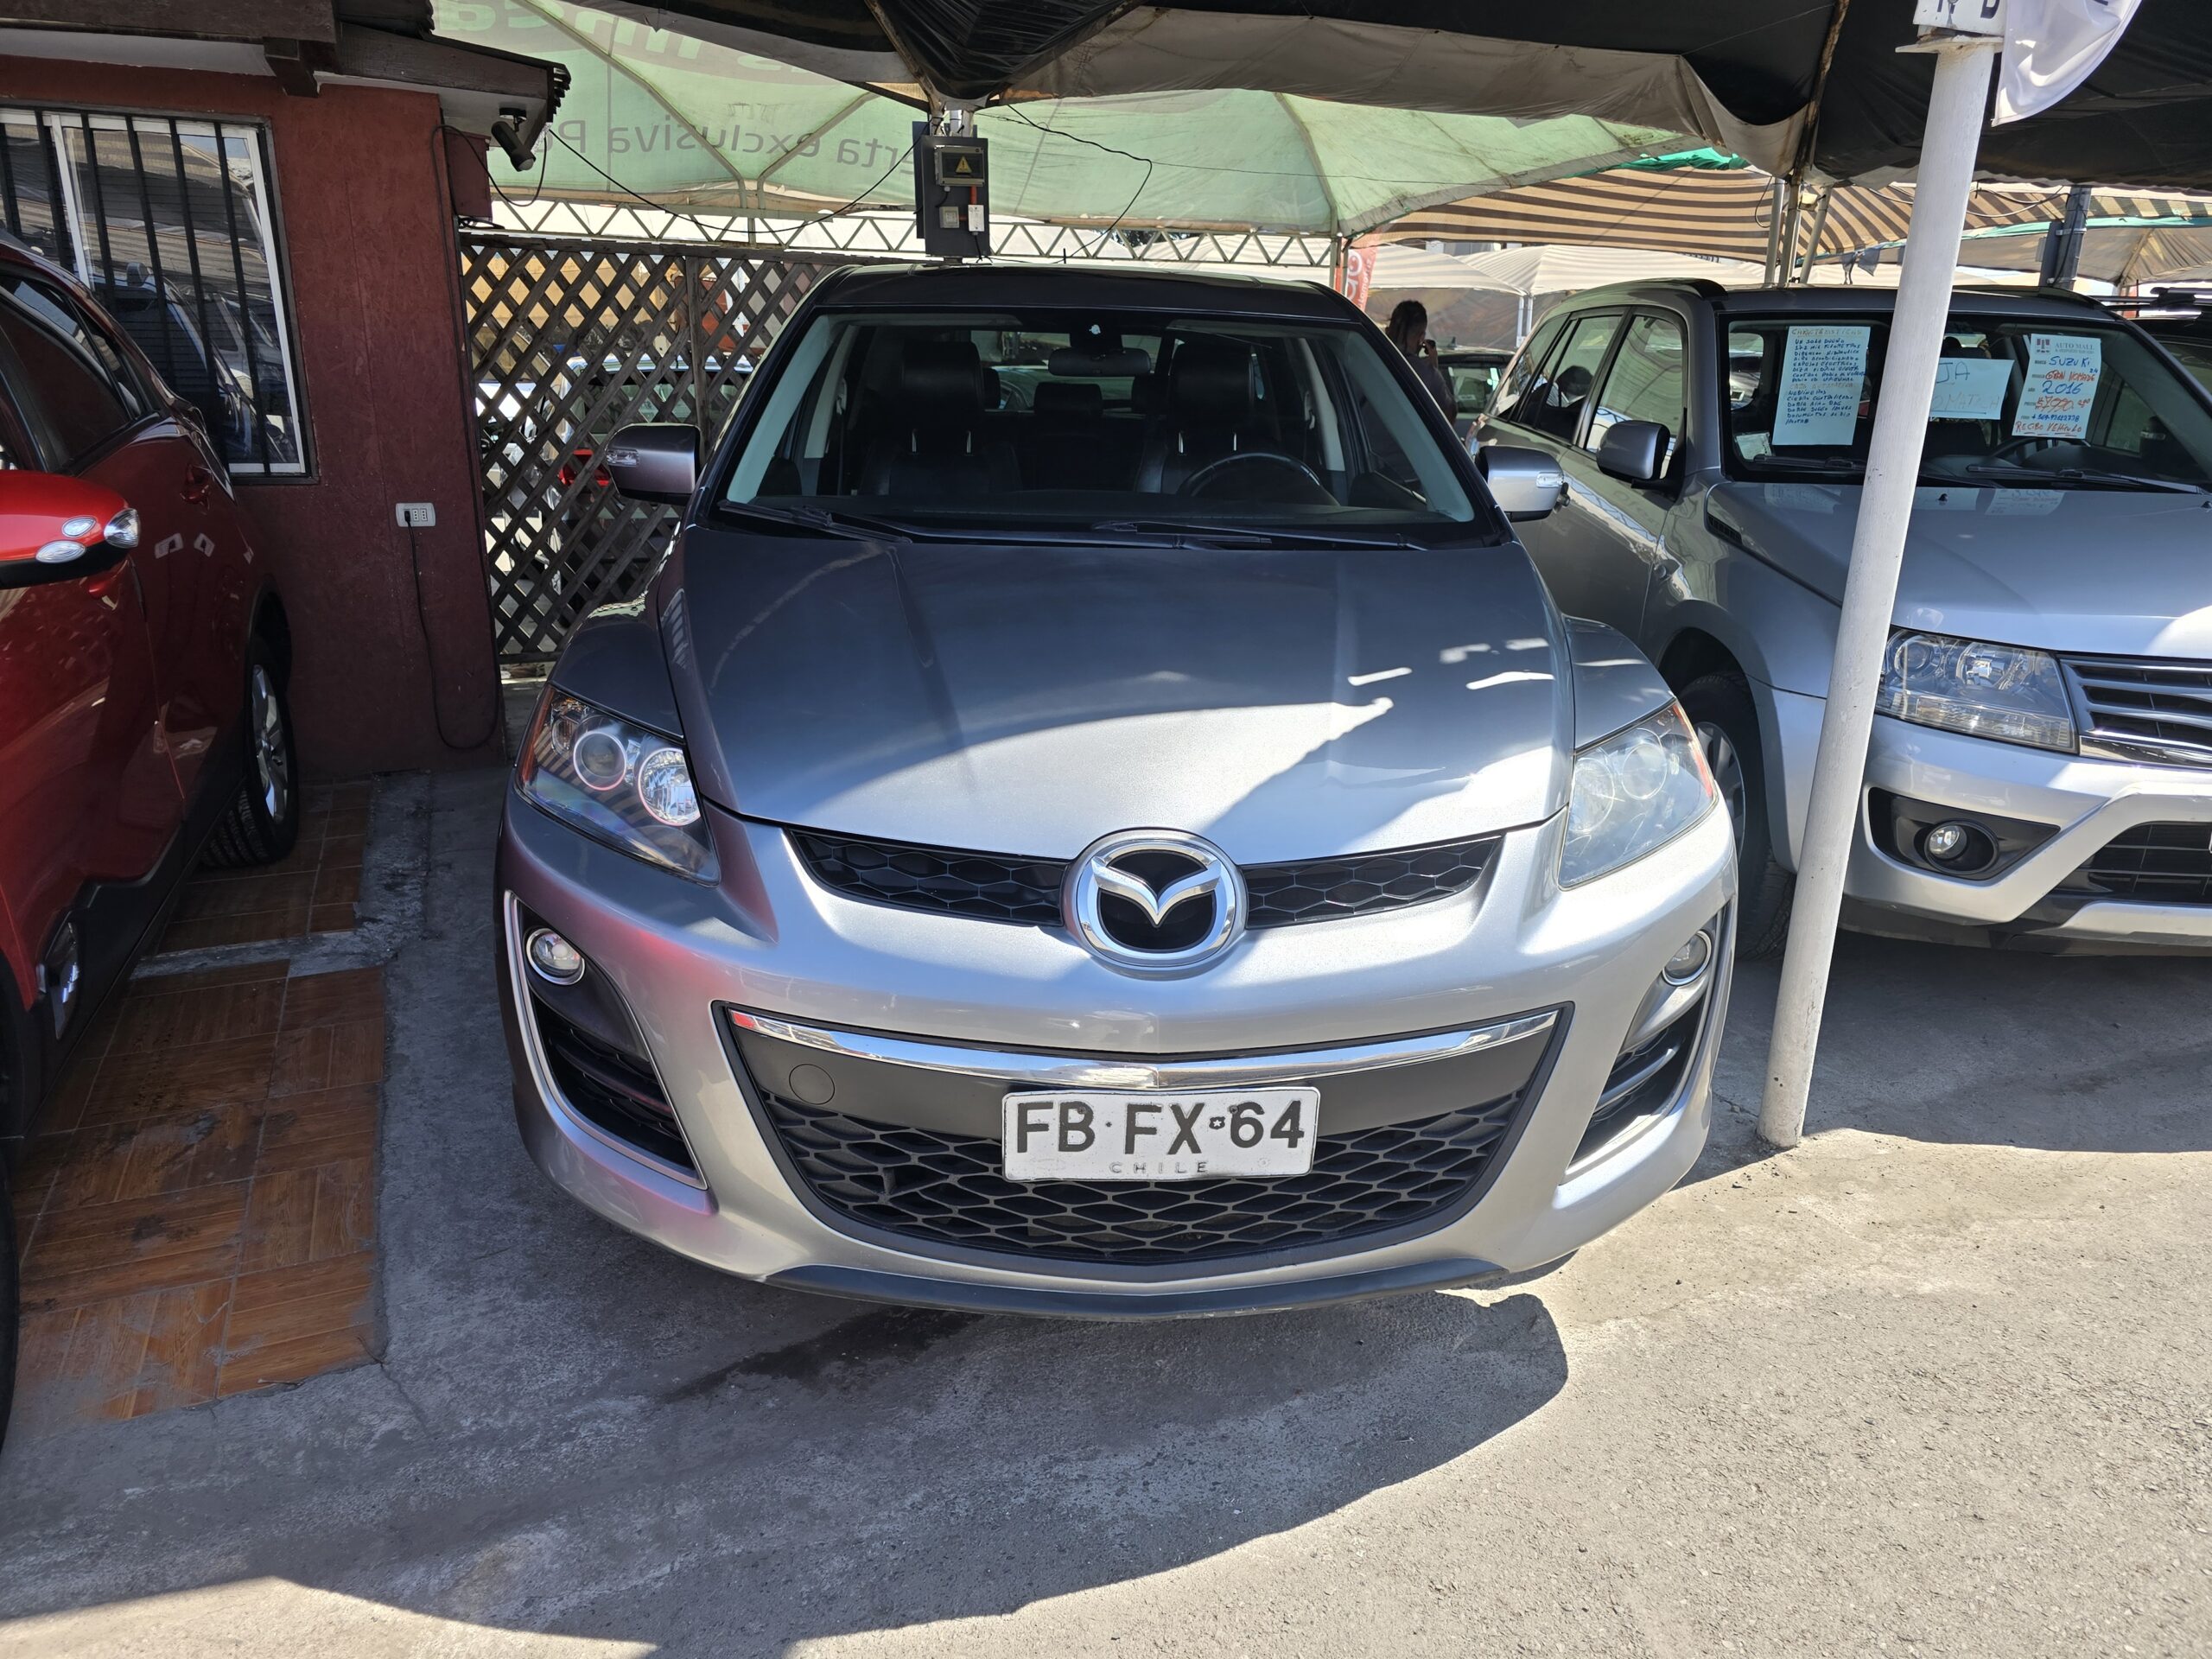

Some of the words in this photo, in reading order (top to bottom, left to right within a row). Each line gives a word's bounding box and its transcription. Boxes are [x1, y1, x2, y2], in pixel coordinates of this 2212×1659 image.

[2049, 355, 2089, 367] SUZUKI
[1935, 360, 1971, 384] JA
[2042, 380, 2083, 394] 2016
[1230, 1099, 1306, 1150] 64
[1109, 1160, 1209, 1174] CHILE
